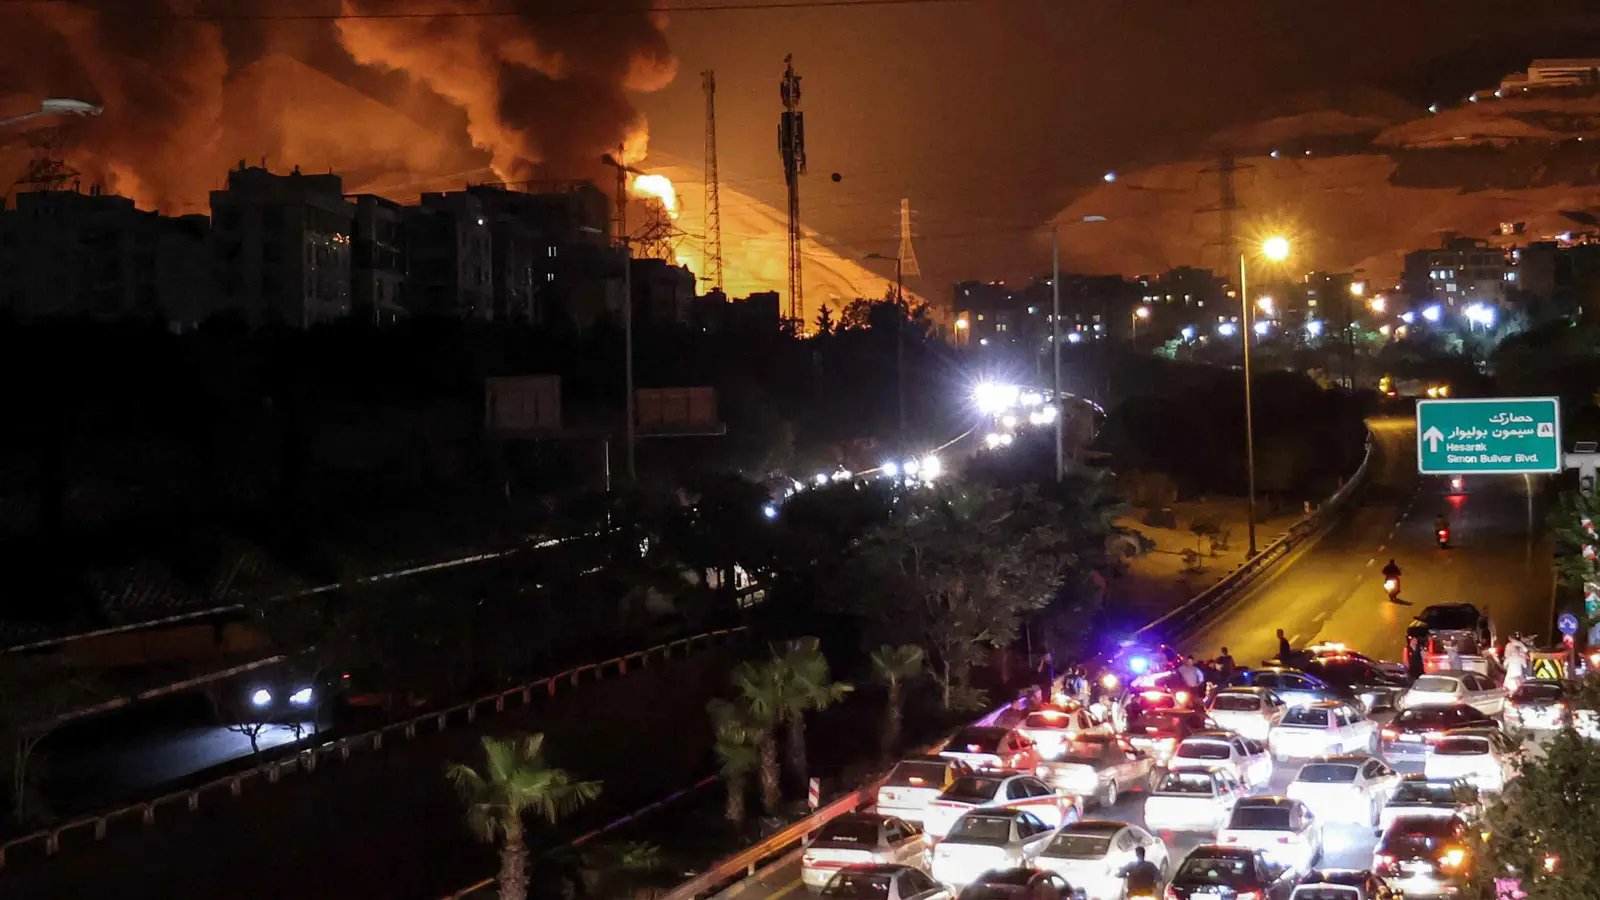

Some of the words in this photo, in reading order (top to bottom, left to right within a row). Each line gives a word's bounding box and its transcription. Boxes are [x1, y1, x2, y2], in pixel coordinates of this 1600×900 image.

[1448, 426, 1488, 440] بولیوار
[1492, 428, 1534, 440] سیمون
[1446, 443, 1487, 452] Hesarak
[1447, 454, 1477, 463] Simon
[1480, 454, 1512, 463] Bulivar
[1515, 453, 1539, 462] Blvd.
